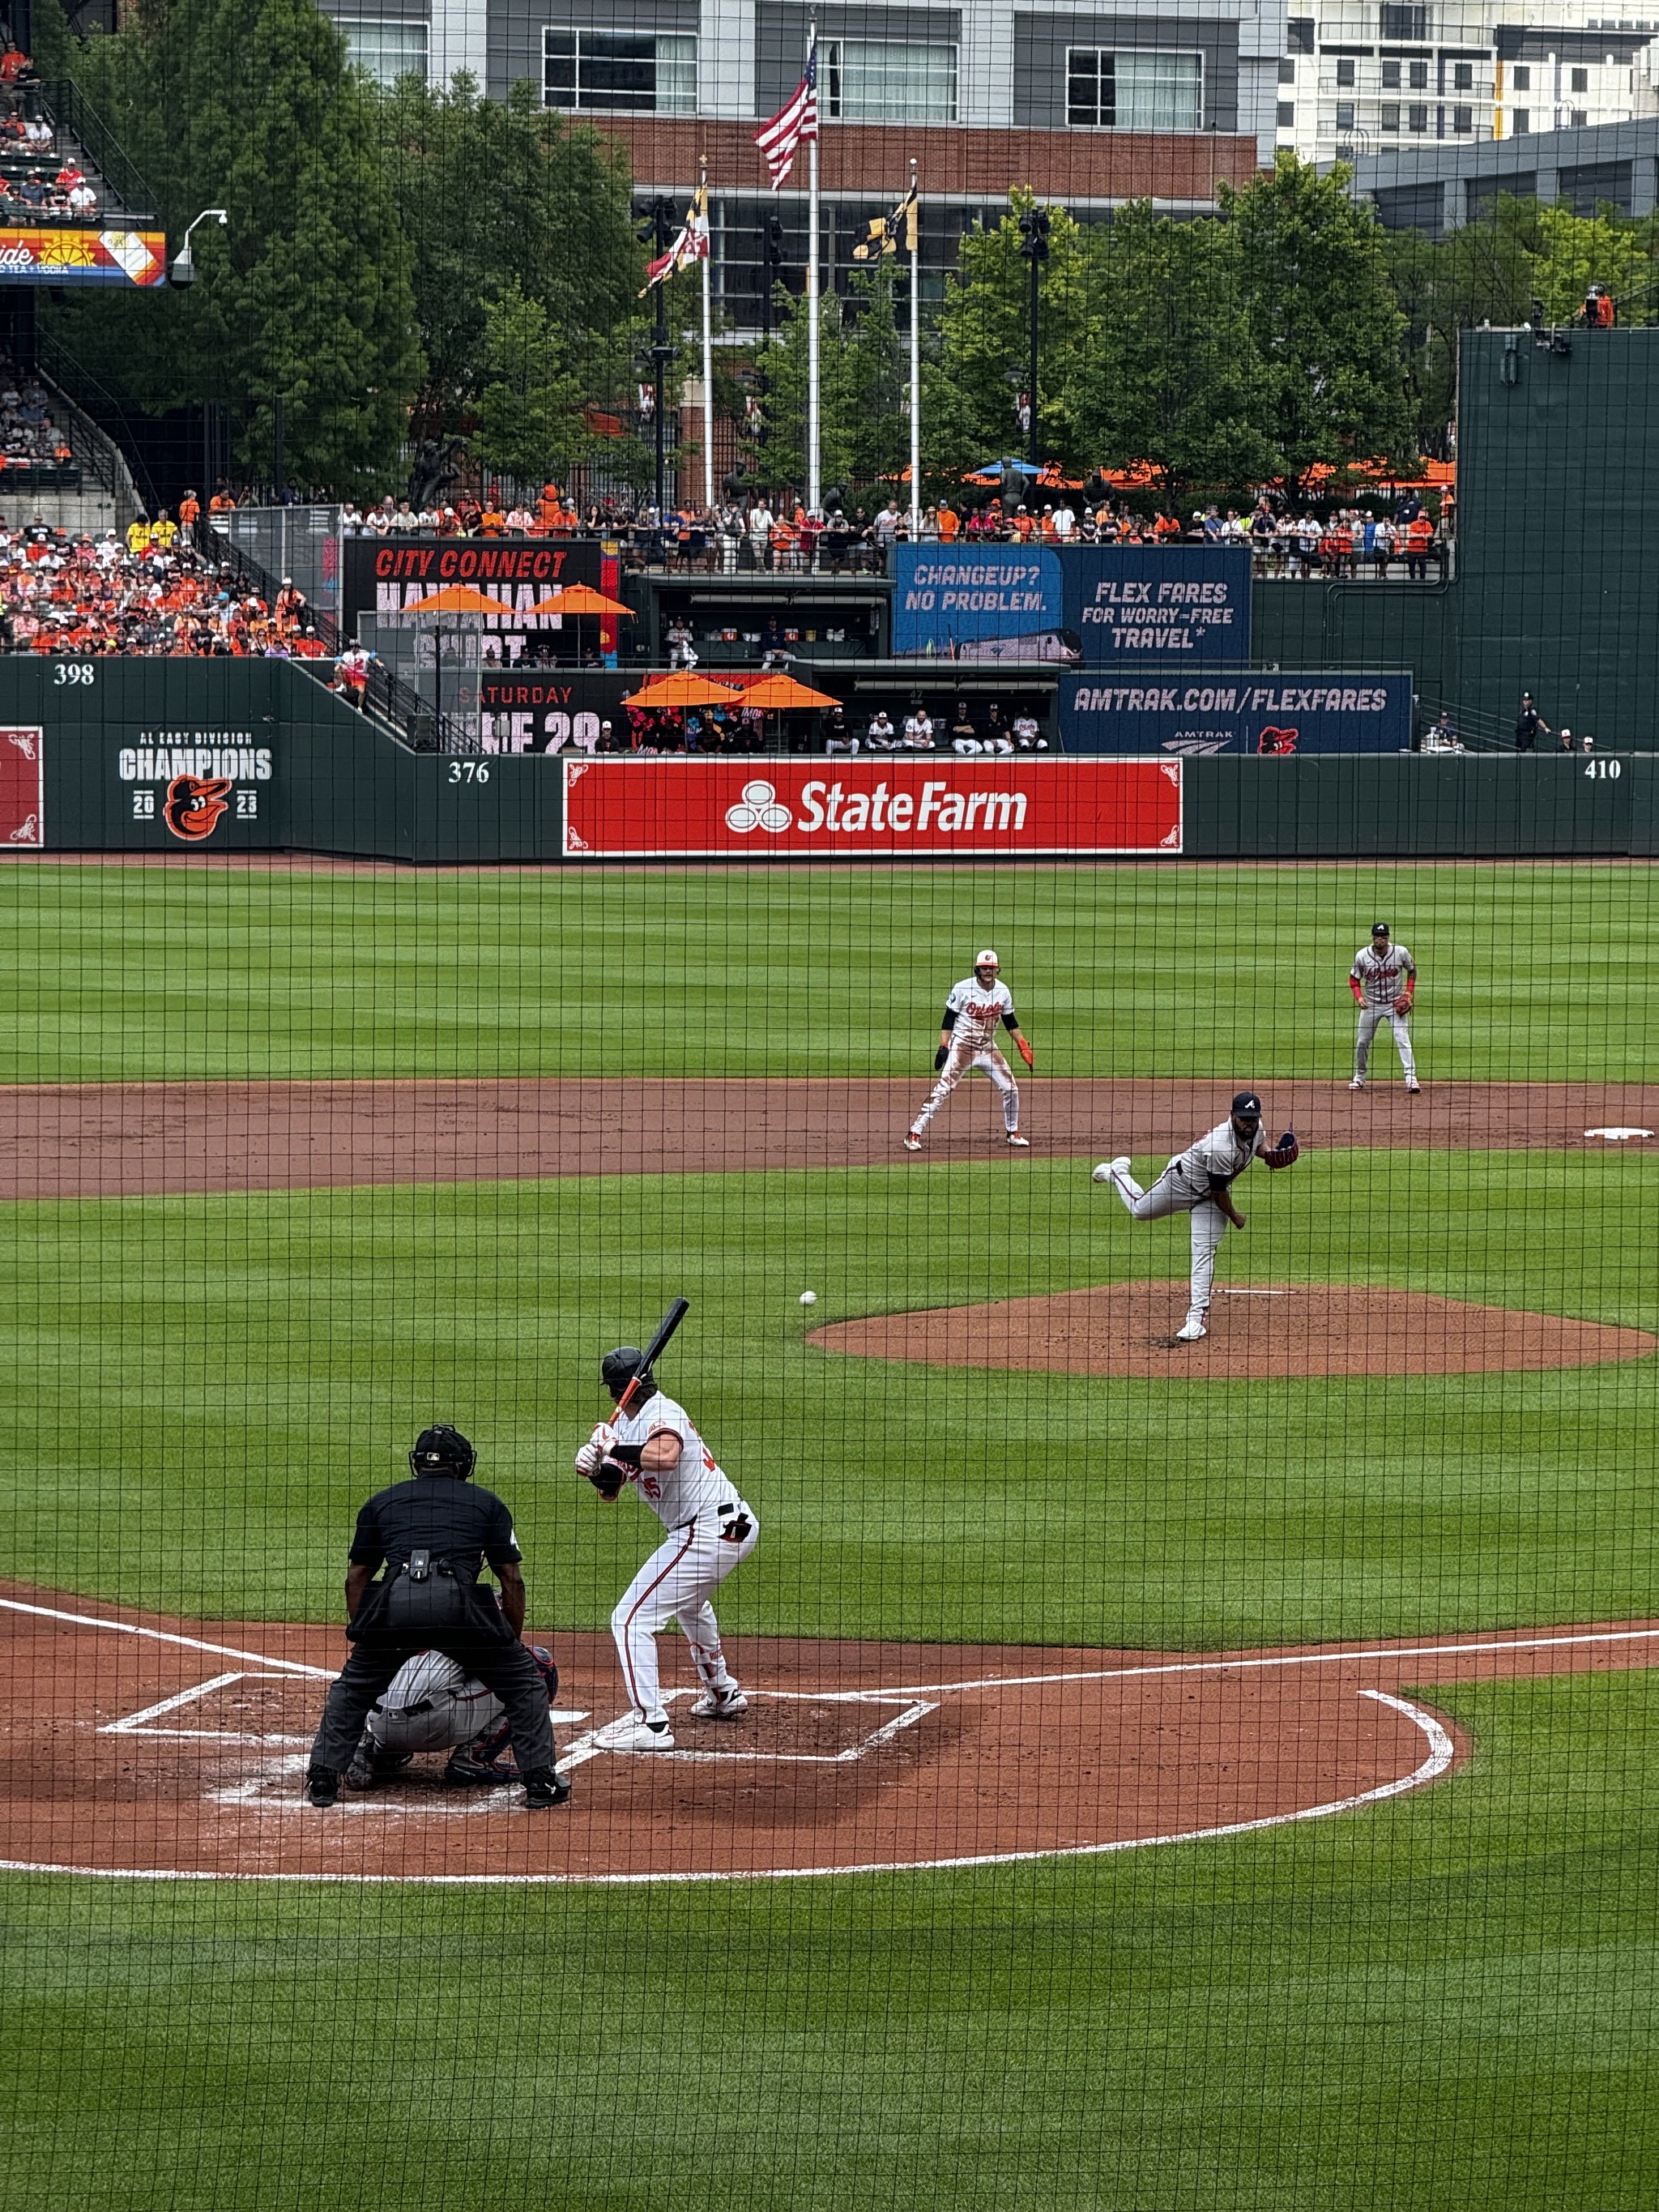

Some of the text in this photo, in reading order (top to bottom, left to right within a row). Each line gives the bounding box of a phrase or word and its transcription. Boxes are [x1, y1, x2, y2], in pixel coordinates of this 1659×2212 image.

[376, 549, 567, 578] CITY CONNECT
[914, 565, 1040, 586] CHANGEUP?
[905, 590, 1047, 611] NO PROBLEM.
[1095, 582, 1228, 604] FLEX FARES
[1081, 607, 1234, 624] FOR WORRY-FREE
[53, 664, 95, 685] 398
[459, 686, 572, 704] SATURDAY
[1074, 687, 1387, 714] AMTRAK.COM/FLEXFARES
[140, 732, 252, 745] AL EAST DIVISION
[439, 711, 599, 754] UNE 29
[119, 748, 272, 780] CHAMPIONS
[449, 762, 490, 784] 376
[1584, 759, 1621, 779] 410
[133, 796, 257, 813] 20 23
